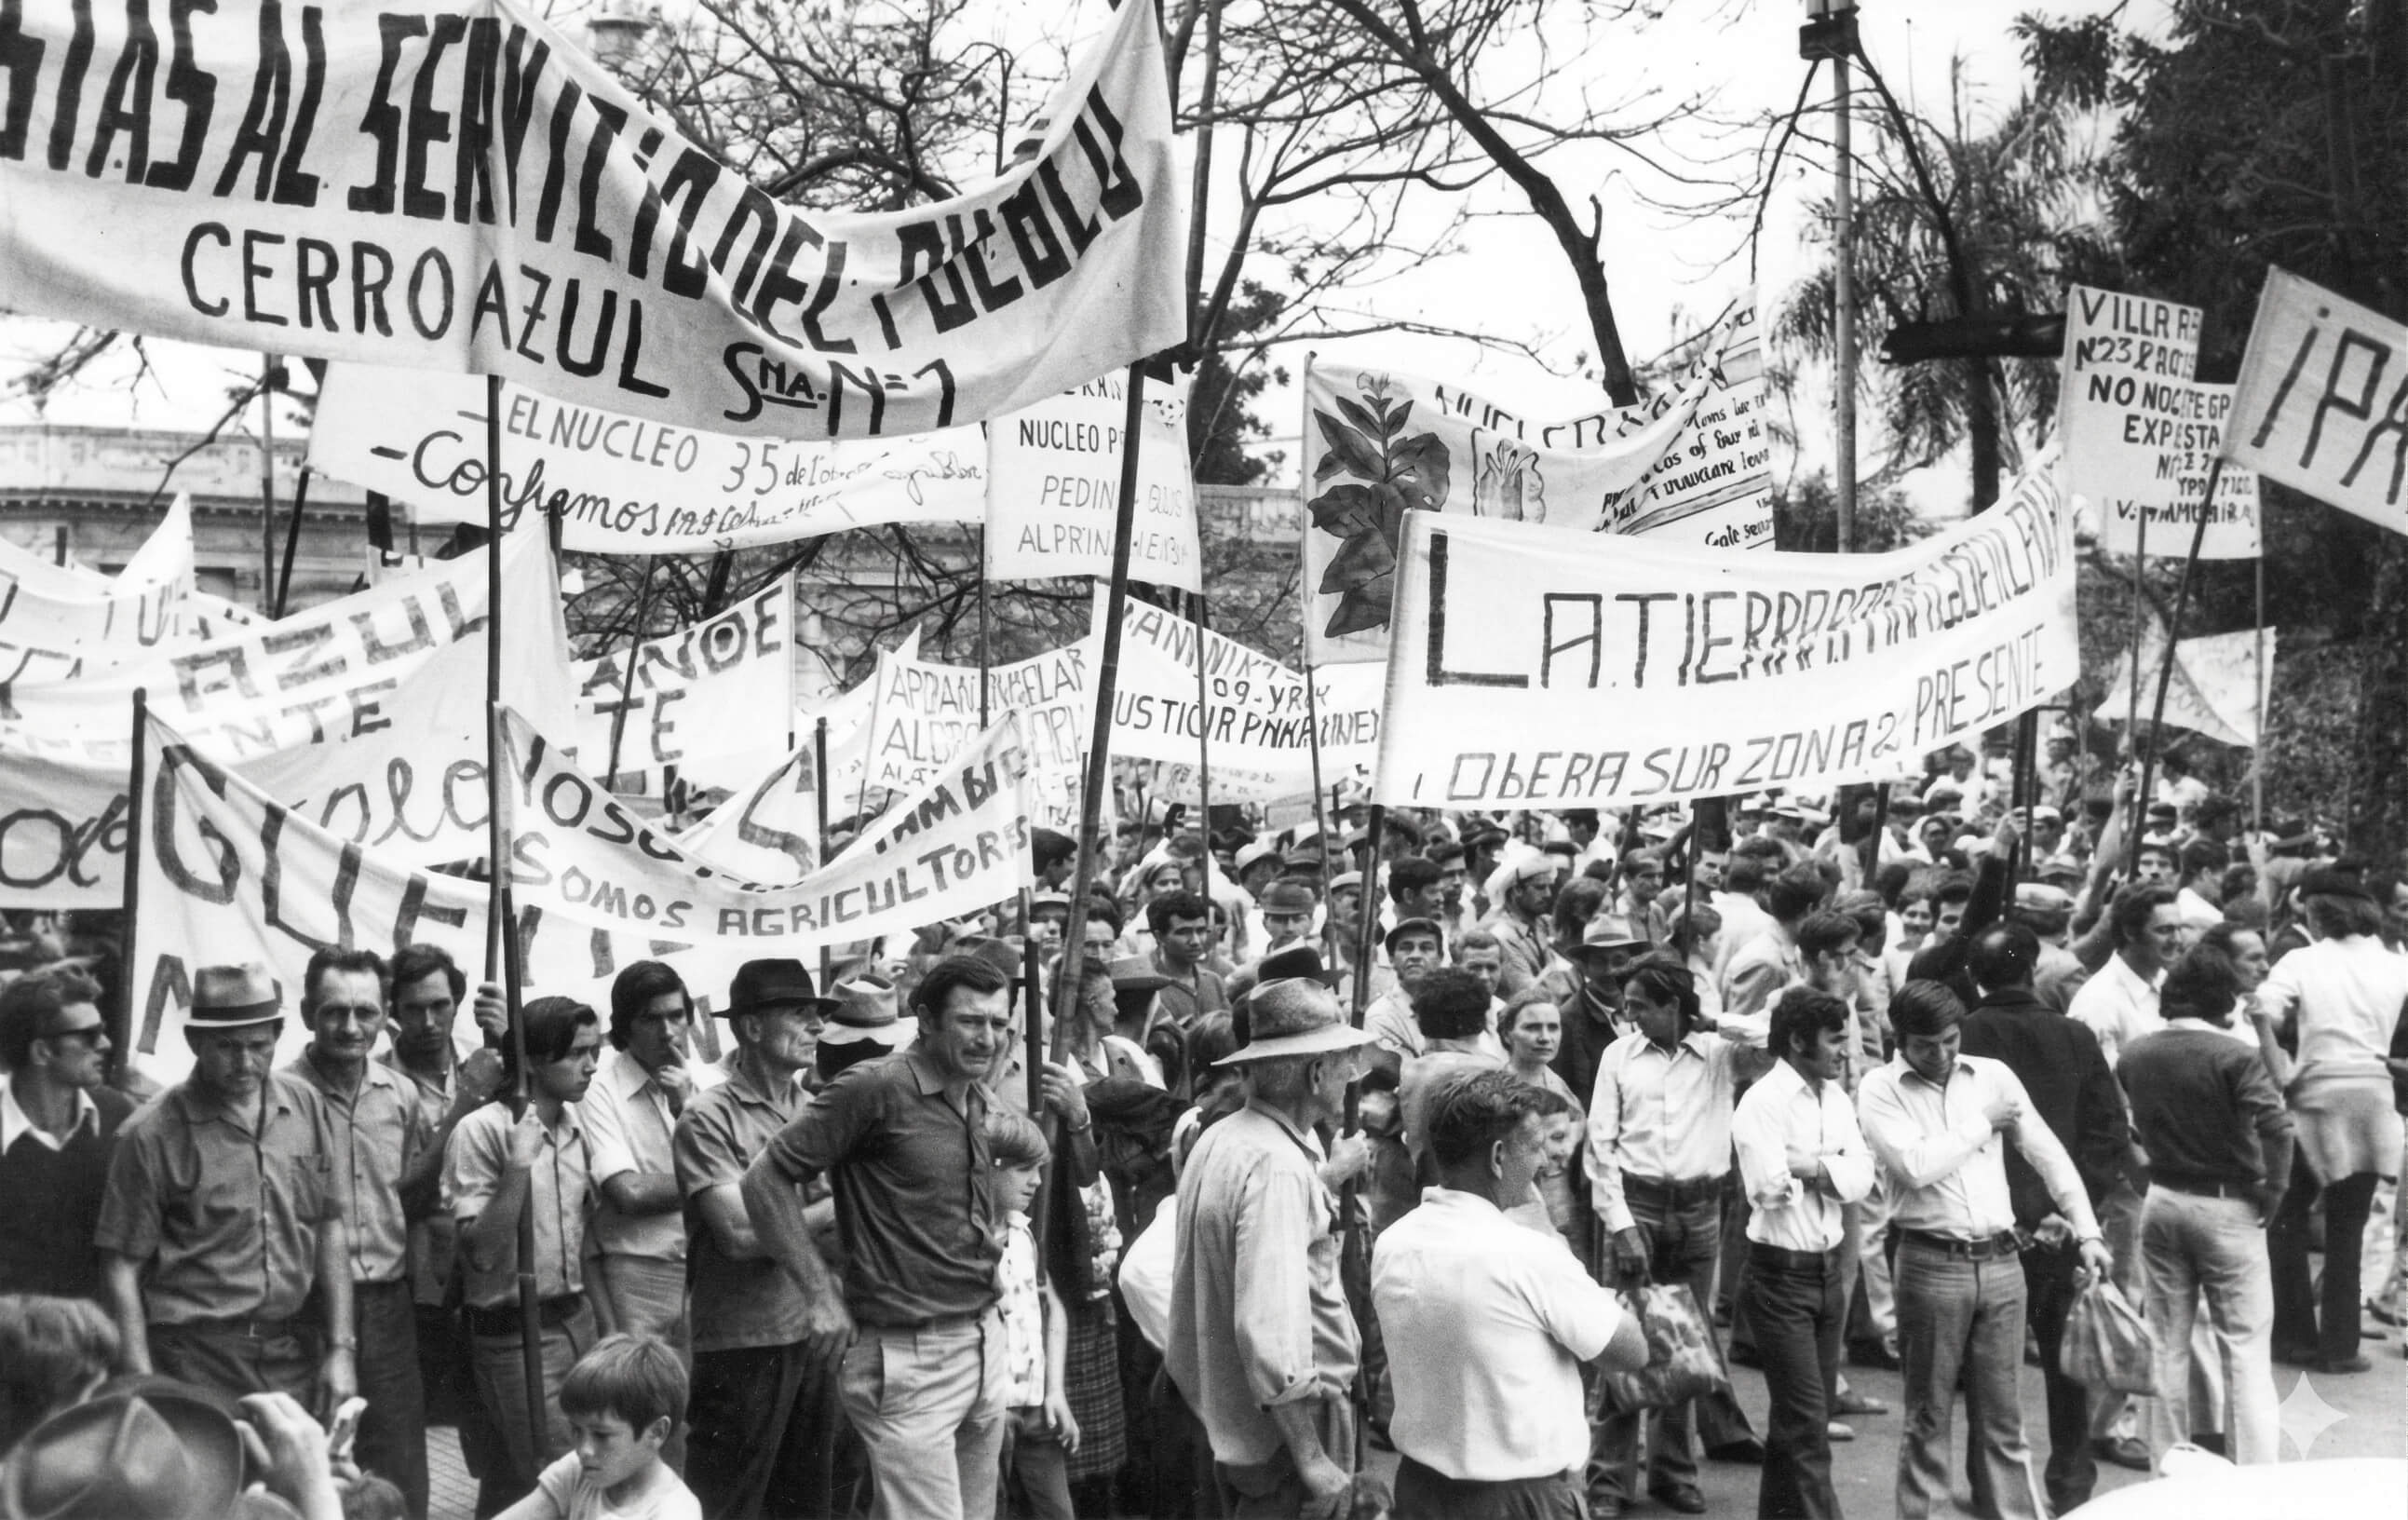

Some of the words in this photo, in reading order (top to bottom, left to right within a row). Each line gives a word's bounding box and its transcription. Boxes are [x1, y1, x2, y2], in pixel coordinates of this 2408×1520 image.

[213, 0, 327, 207] AL
[181, 222, 454, 340] CERRO
[470, 259, 670, 397] AZUL
[548, 406, 698, 473] NUCLEO
[721, 441, 778, 495] 35
[1020, 419, 1100, 454] NUCLEO
[1630, 740, 1731, 797] SUR
[1735, 718, 1869, 786] ZONA
[1914, 622, 2047, 749] PRESENTE
[511, 831, 694, 929] SOMOS
[716, 814, 1029, 937] AGRICULTORES
